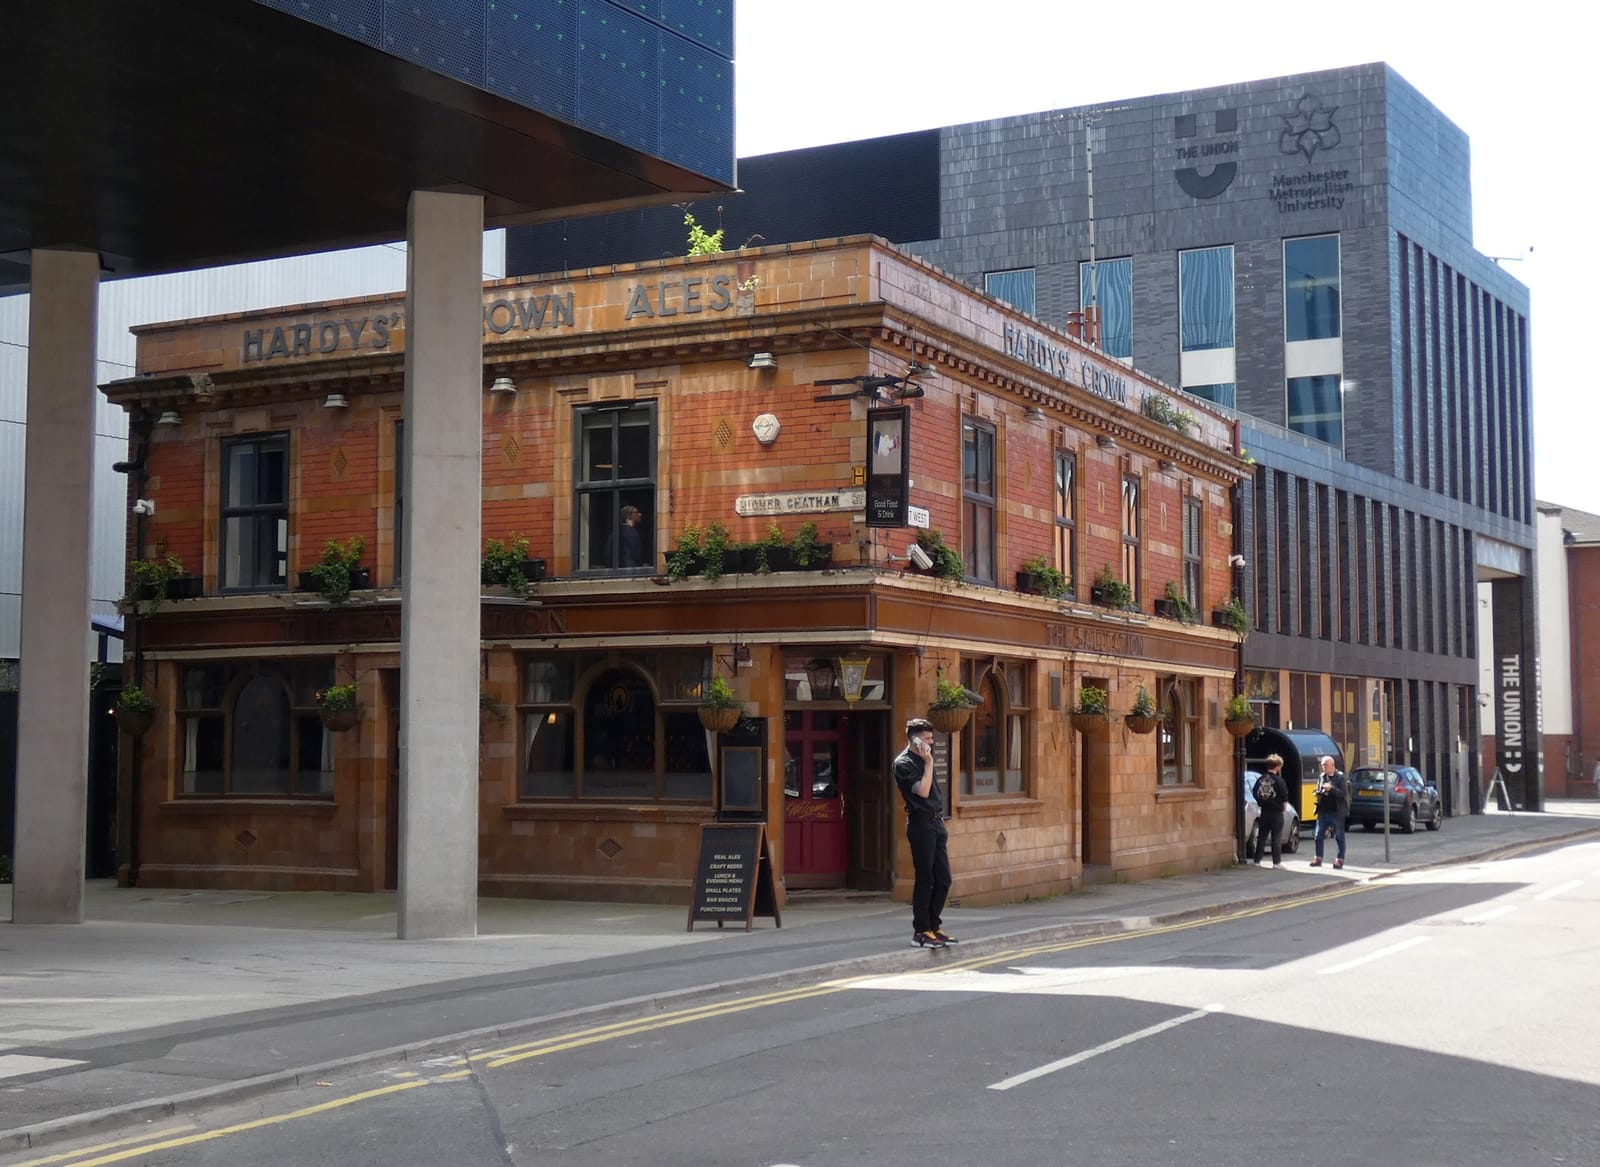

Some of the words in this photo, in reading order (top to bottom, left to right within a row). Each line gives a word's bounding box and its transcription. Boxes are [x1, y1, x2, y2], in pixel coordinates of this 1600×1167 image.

[1176, 146, 1198, 160] THE
[1201, 141, 1239, 156] UNION
[1273, 169, 1349, 187] Manchester
[1269, 182, 1354, 201] Metropolitan
[1278, 196, 1345, 214] University
[243, 312, 401, 363] HARDYS'
[483, 291, 575, 336] OWN
[625, 275, 732, 320] ALES
[1081, 360, 1127, 407] CROWN
[787, 495, 840, 509] CHATHAM
[874, 500, 886, 508] Good
[887, 500, 898, 508] Food
[913, 511, 926, 526] WEST
[1502, 654, 1520, 688] THE
[1504, 690, 1522, 747] UNION
